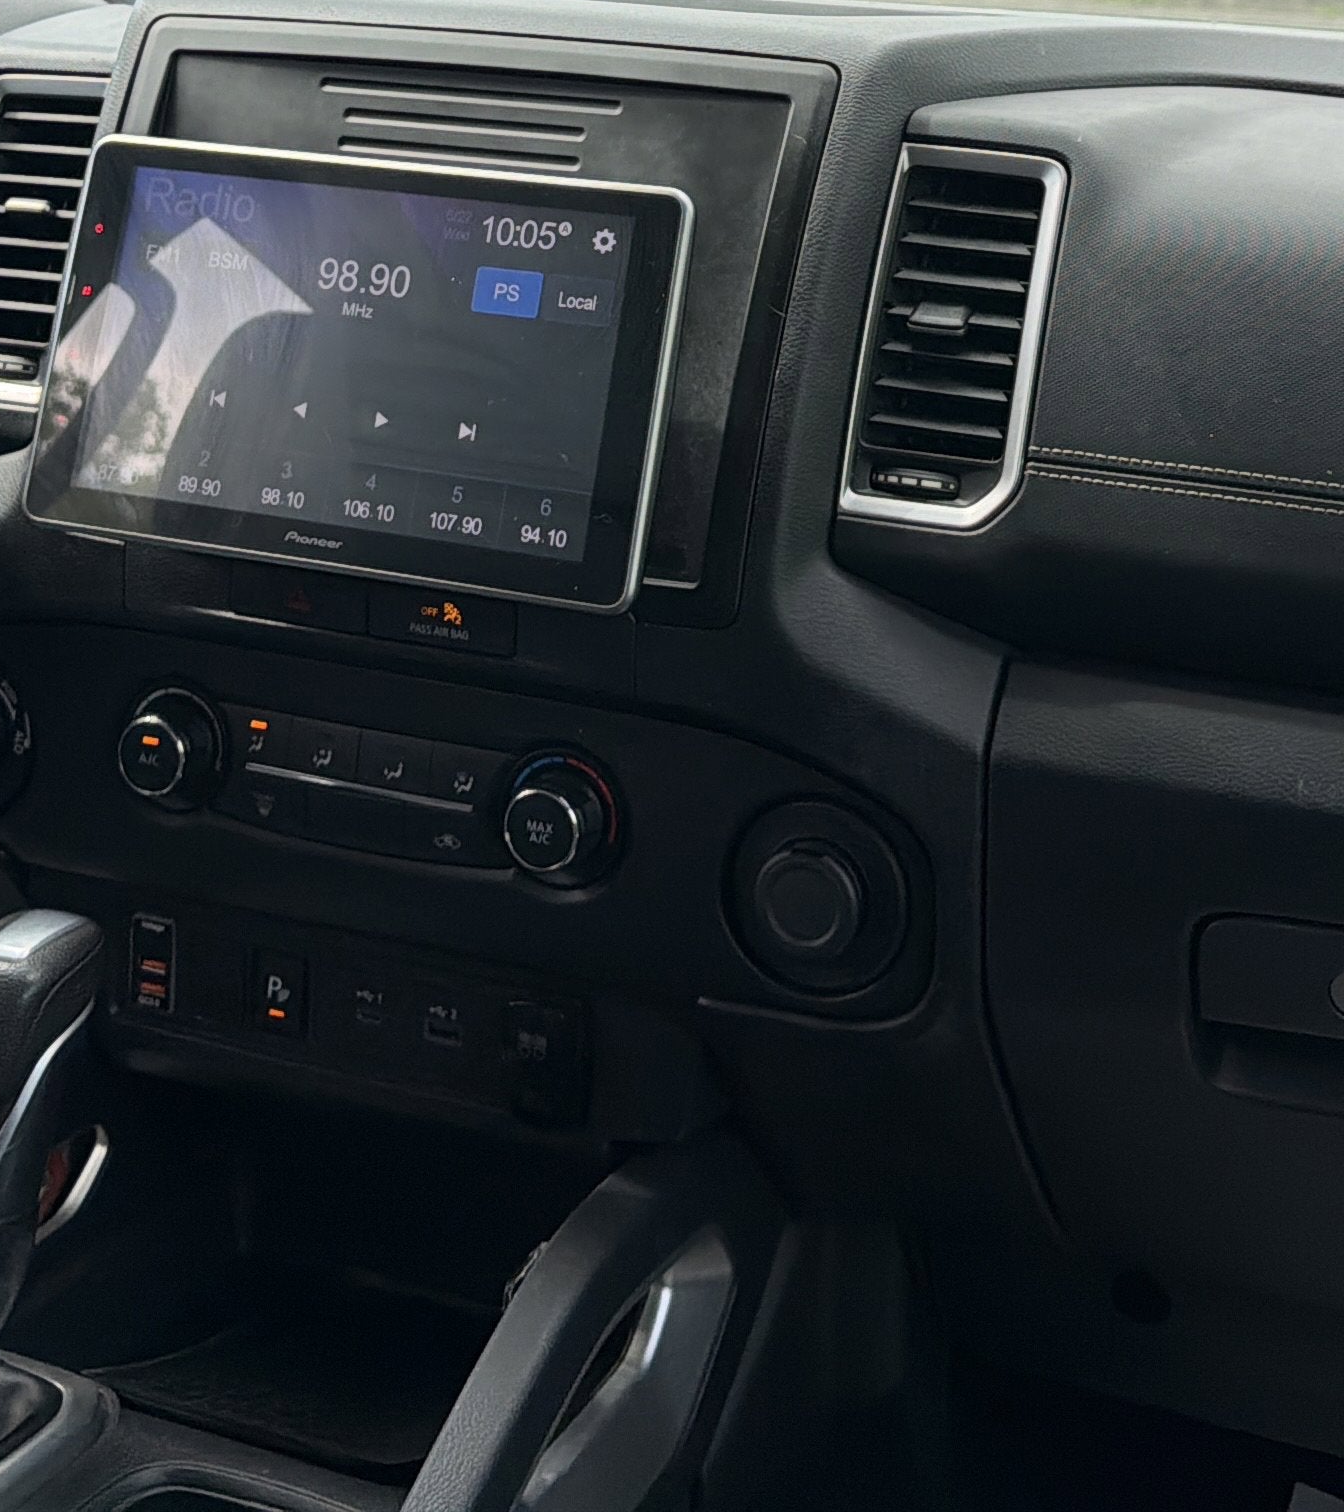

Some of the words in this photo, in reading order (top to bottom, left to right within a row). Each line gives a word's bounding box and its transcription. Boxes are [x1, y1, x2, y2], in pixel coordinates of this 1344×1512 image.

[144, 177, 255, 223] Radio
[483, 215, 559, 250] 10:05
[146, 243, 181, 264] FM1
[208, 250, 250, 271] BSM
[318, 257, 411, 298] 98.90
[494, 283, 520, 303] PS
[558, 291, 598, 312] Local
[341, 301, 374, 319] MHz
[199, 450, 210, 468] 2
[281, 461, 293, 480] 3
[365, 473, 377, 491] 4
[452, 486, 463, 504] 5
[540, 498, 552, 517] 6
[178, 475, 222, 497] 89.90
[261, 488, 305, 510] 98.10
[343, 499, 395, 523] 106.10
[429, 512, 483, 536] 107.90
[521, 524, 567, 549] 94.10
[284, 530, 344, 551] Pioneer
[420, 606, 438, 617] OFF
[409, 622, 432, 635] PASS
[138, 751, 161, 767] A/C
[526, 818, 554, 835] MAX
[529, 832, 551, 846] A/C
